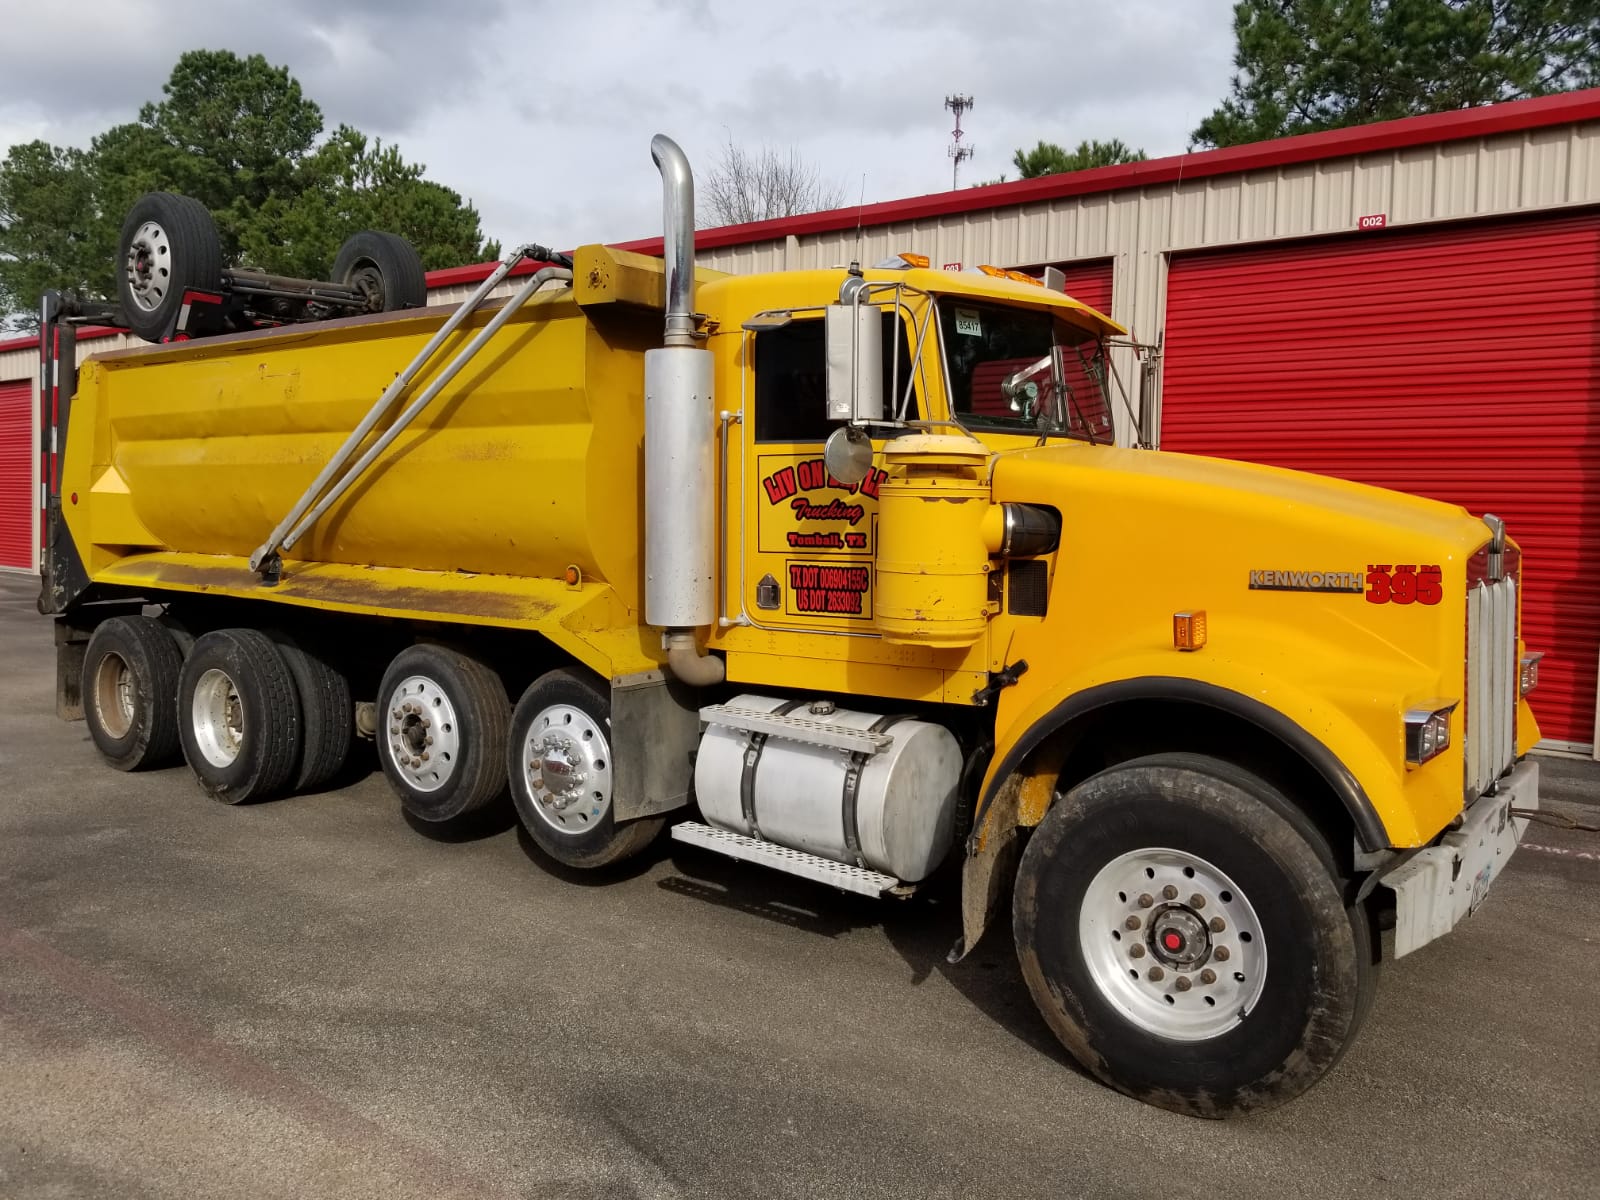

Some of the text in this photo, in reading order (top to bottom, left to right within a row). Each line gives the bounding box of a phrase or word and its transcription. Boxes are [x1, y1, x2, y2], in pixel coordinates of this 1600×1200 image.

[1362, 216, 1383, 227] 002
[763, 466, 798, 505] LIV
[797, 459, 826, 491] ON
[790, 497, 865, 526] Trucking
[787, 532, 867, 549] Tomball, TX
[790, 565, 802, 589] TX
[802, 565, 819, 589] DOT
[1249, 569, 1363, 591] KENWORTH
[1366, 572, 1443, 606] 395
[796, 588, 809, 611] US
[810, 589, 826, 612] DOT
